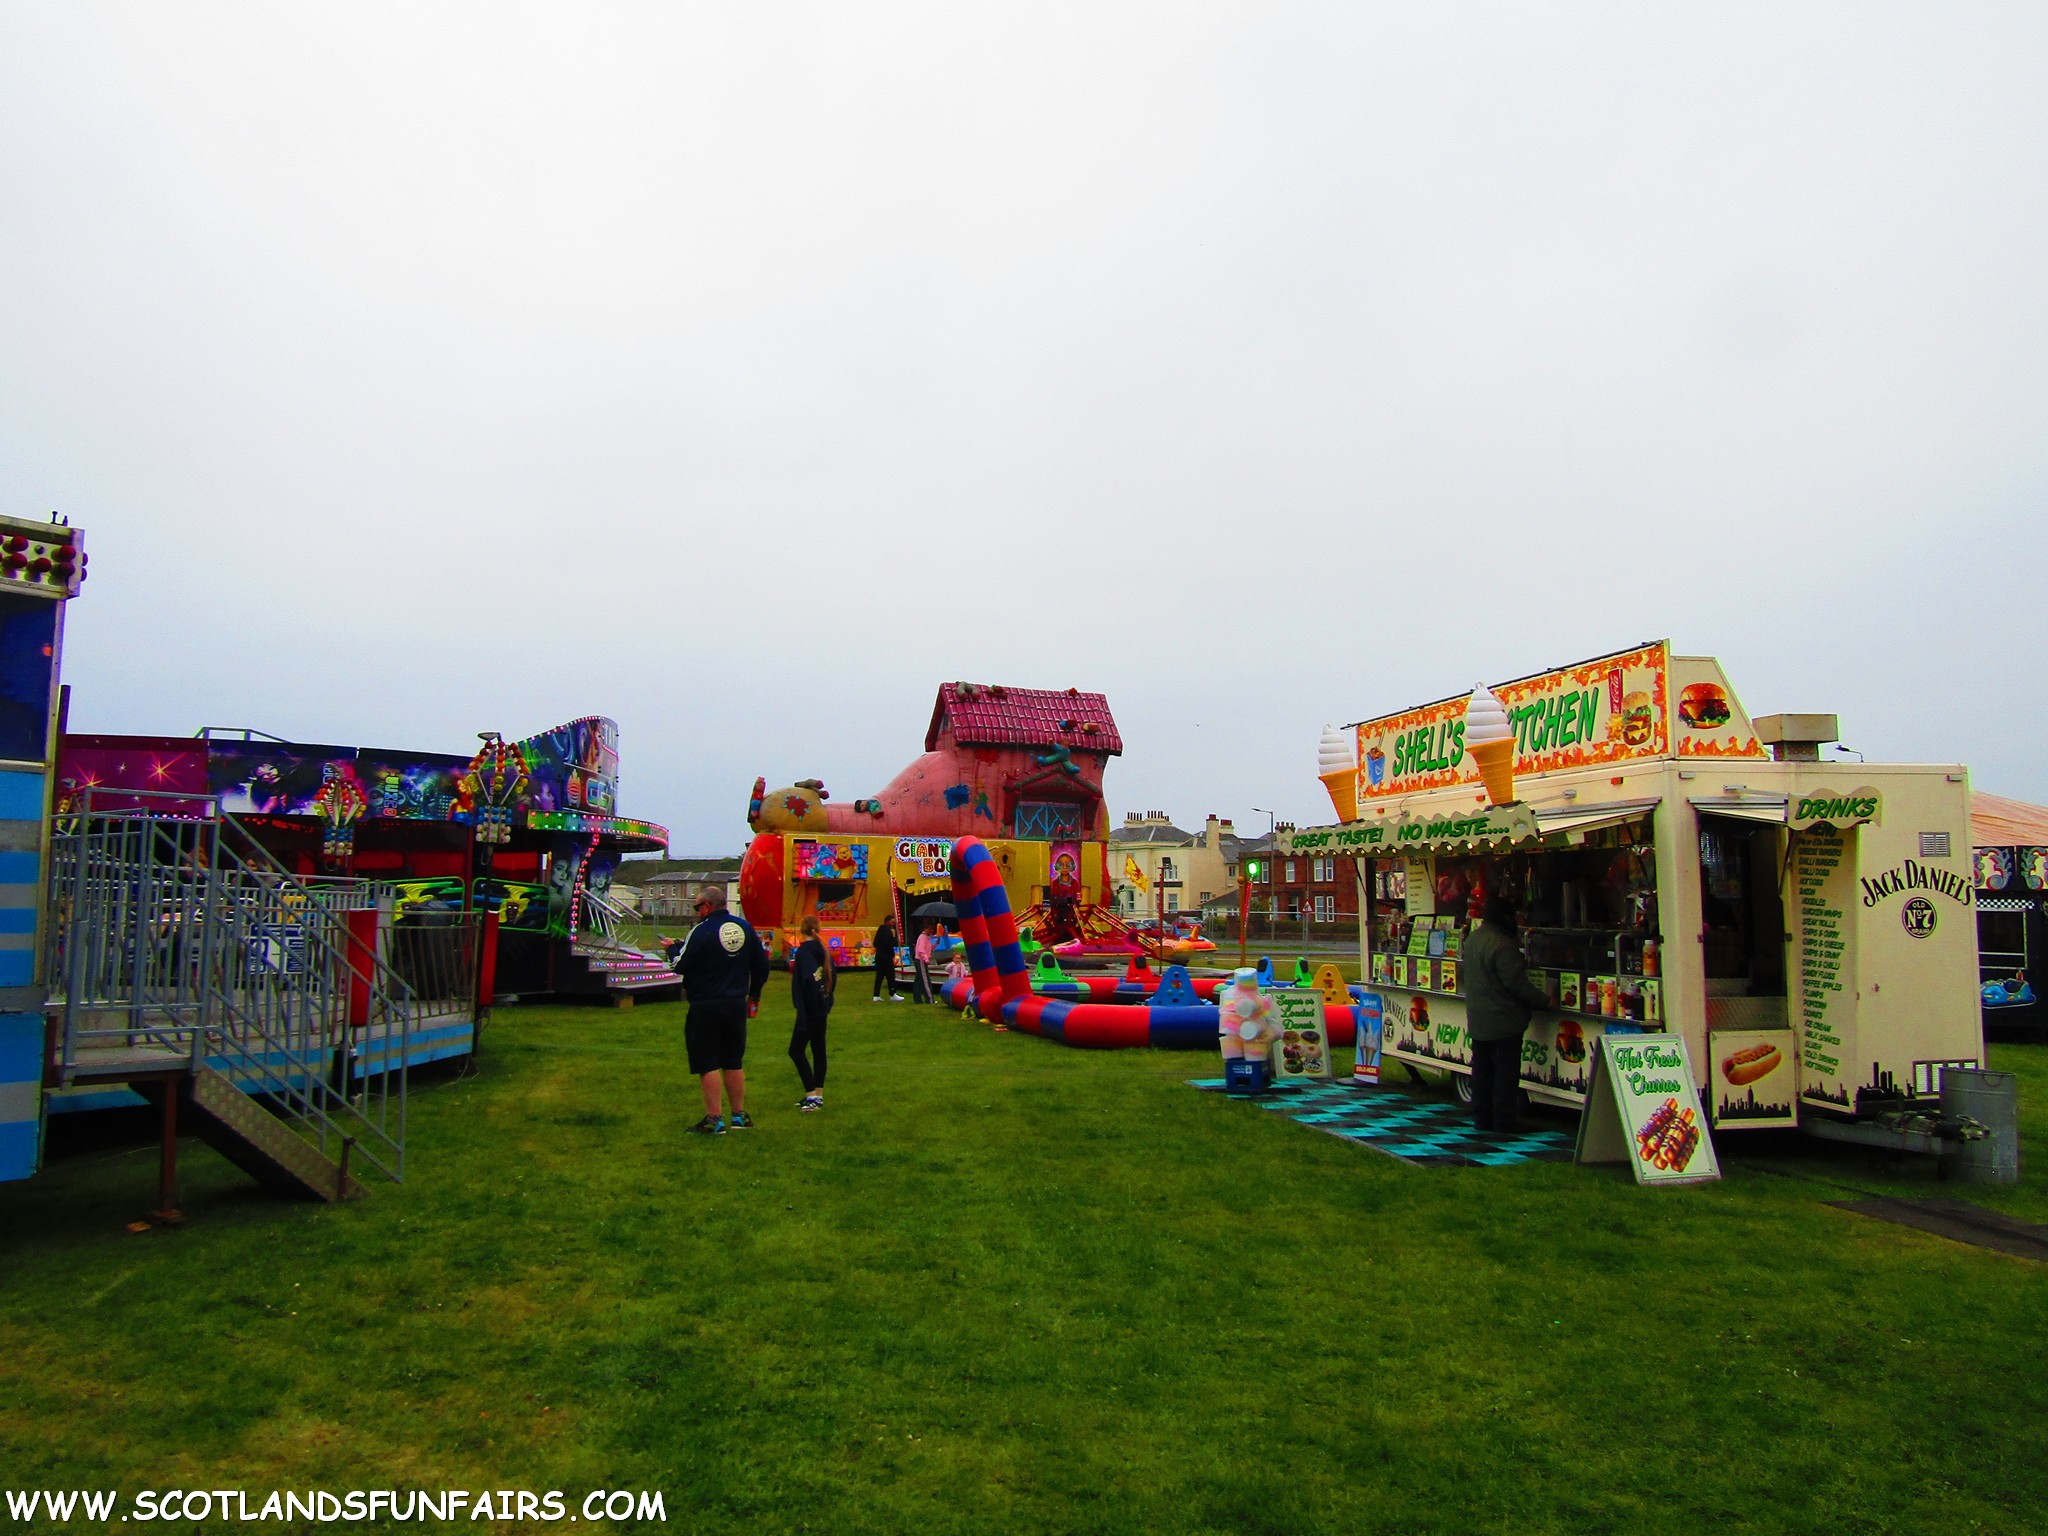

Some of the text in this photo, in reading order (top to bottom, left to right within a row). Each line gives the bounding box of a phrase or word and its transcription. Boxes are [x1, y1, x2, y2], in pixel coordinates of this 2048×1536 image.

[1393, 687, 1599, 777] SHELL'S ITCHEN
[1795, 797, 1878, 820] DRINKS
[1291, 833, 1332, 848] GREAT
[1337, 828, 1384, 846] TASTE!
[1397, 823, 1423, 841] NO
[899, 842, 950, 857] GIANT
[922, 858, 952, 872] BO
[1860, 859, 1975, 907] JACK DANIEL'S
[1802, 898, 1826, 906] NOODLES
[1802, 928, 1818, 936] CHIPS
[1802, 938, 1818, 946] CHIPS
[1825, 940, 1845, 950] CHEESE
[1803, 948, 1818, 957] CHIPS
[1802, 959, 1817, 968] CHIPS
[1819, 971, 1835, 980] FLOSS
[1803, 979, 1842, 991] TOFFEE APPLES
[1276, 994, 1304, 1012] Sugar
[1280, 1008, 1315, 1018] Loaded
[1436, 1023, 1460, 1044] NEW
[1614, 1045, 1681, 1071] Hot Fresh
[1355, 1065, 1366, 1073] SOLD
[1625, 1071, 1681, 1096] Churros
